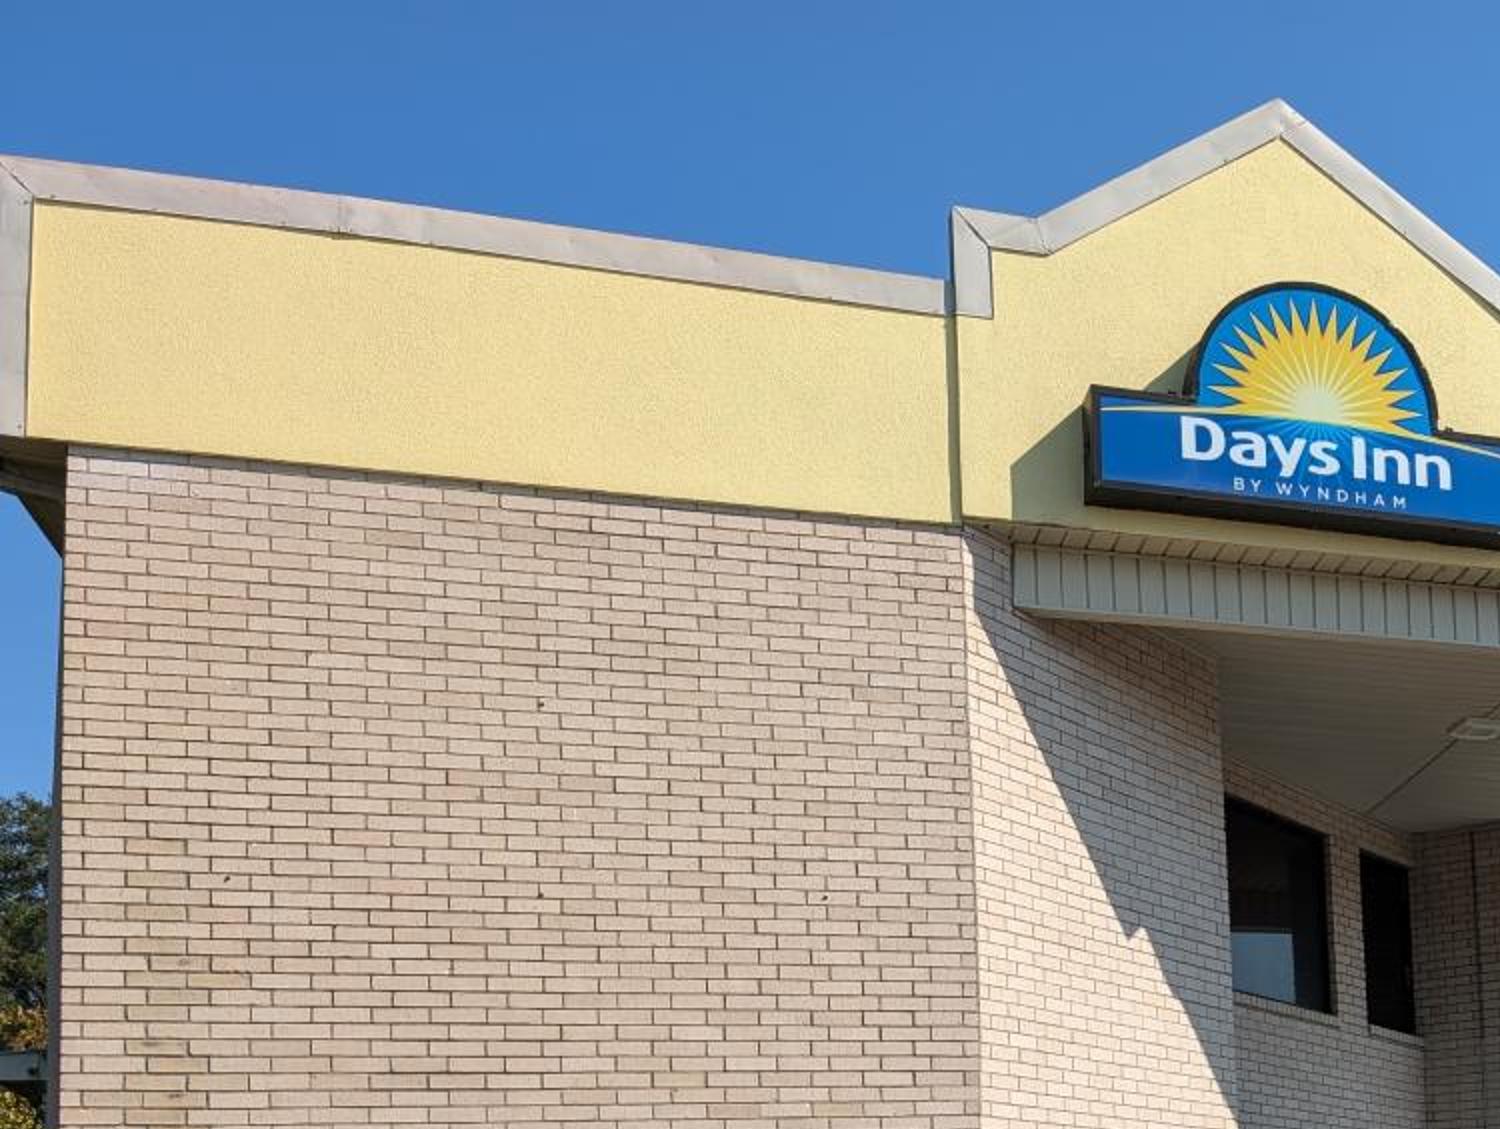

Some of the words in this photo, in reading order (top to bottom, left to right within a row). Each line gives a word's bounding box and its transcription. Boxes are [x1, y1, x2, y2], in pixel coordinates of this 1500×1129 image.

[1181, 416, 1340, 477] Days
[1352, 436, 1452, 490] Inn
[1233, 477, 1261, 492] BY
[1275, 482, 1407, 509] WYNDHAM
